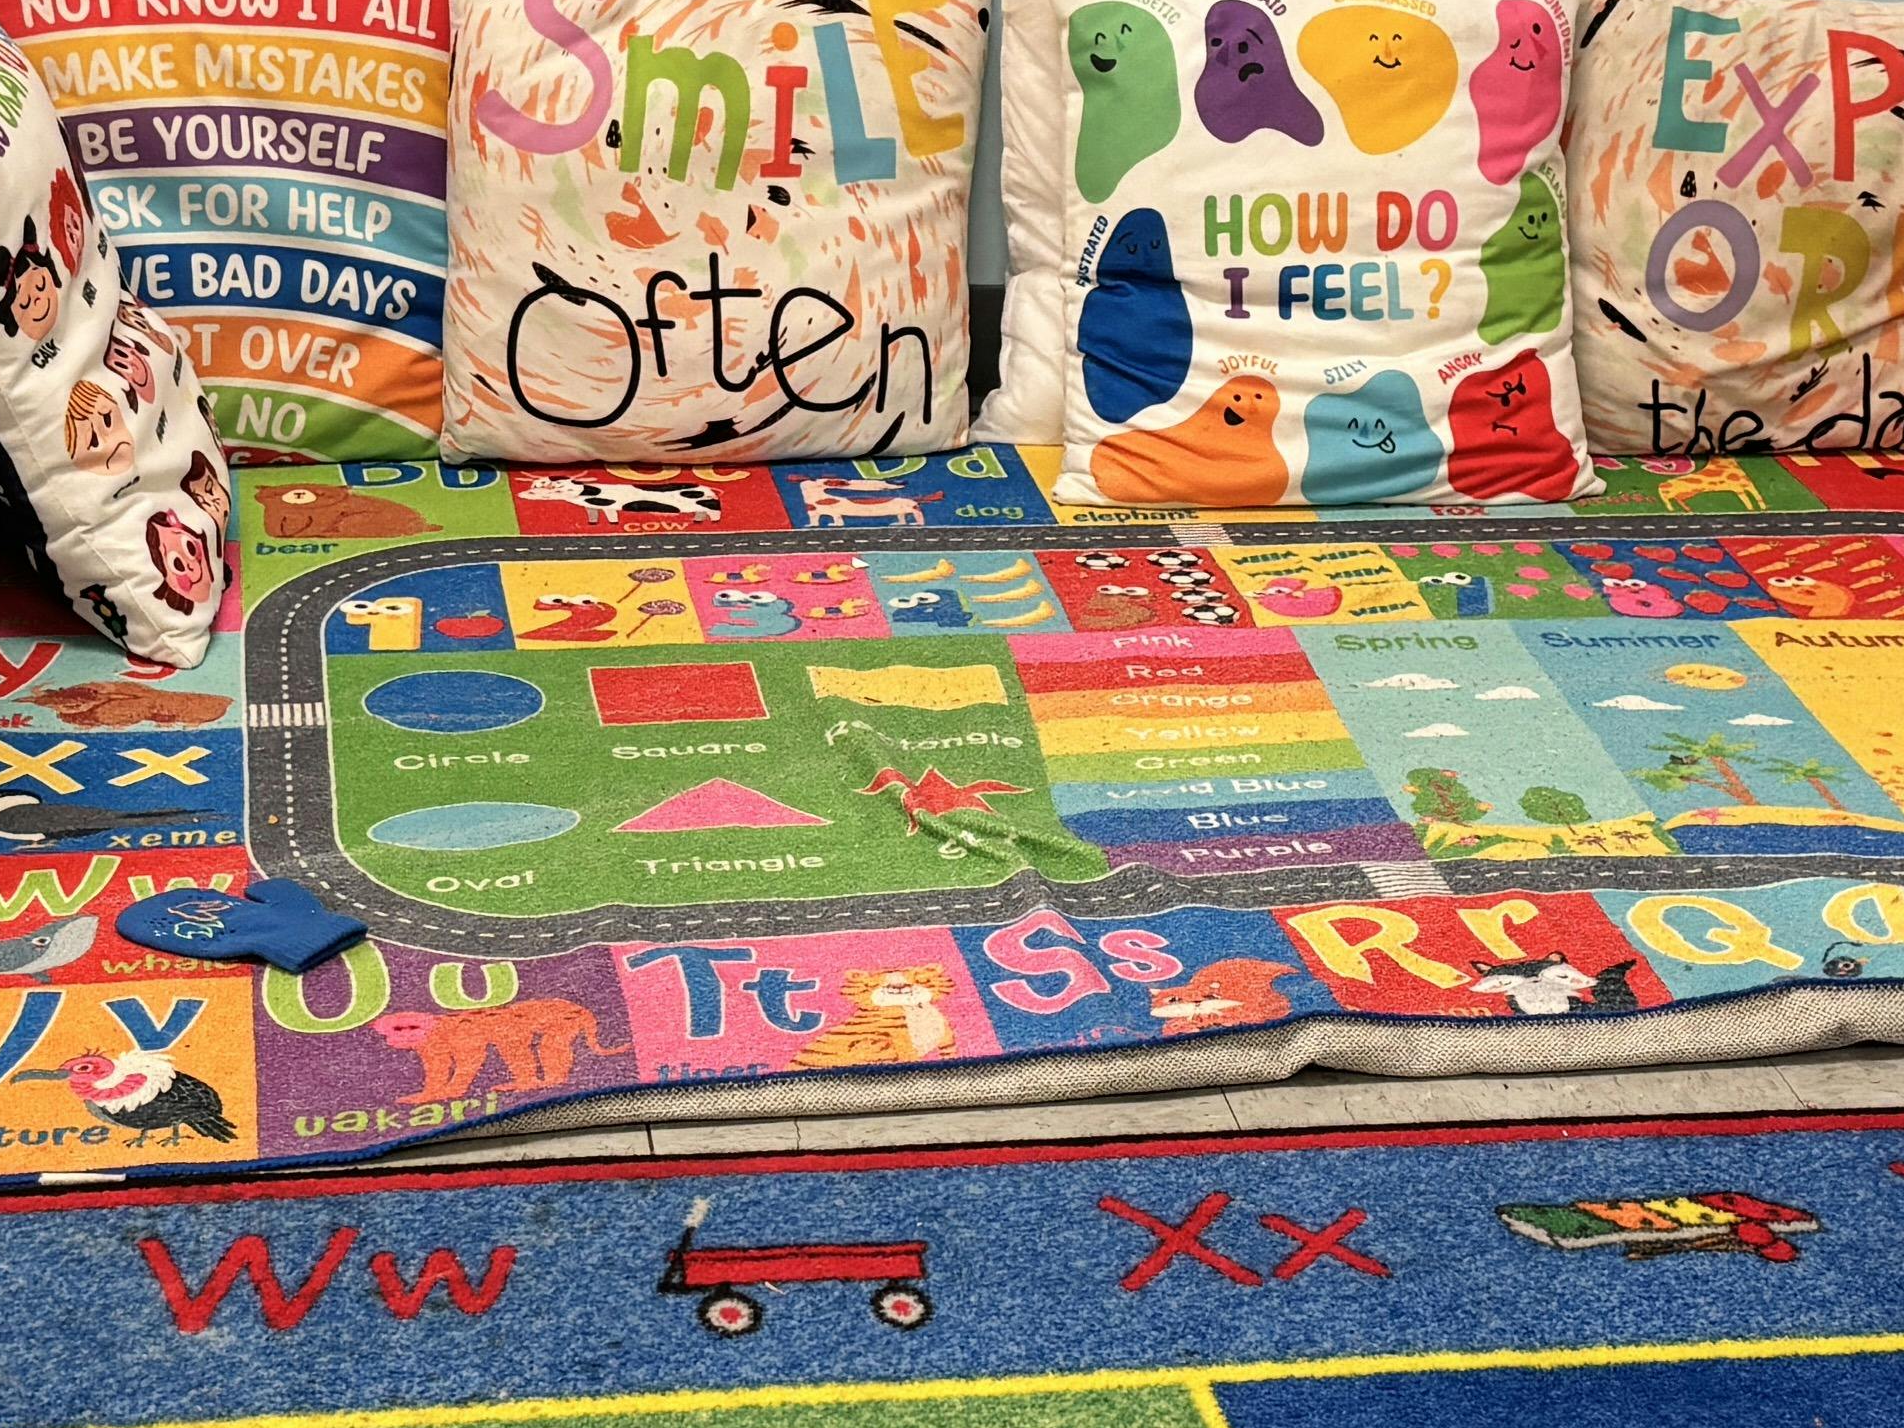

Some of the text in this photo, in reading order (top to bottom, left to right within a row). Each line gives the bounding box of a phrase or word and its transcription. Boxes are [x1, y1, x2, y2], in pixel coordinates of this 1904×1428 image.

[42, 43, 427, 113] MAKE MISTAKES
[78, 114, 385, 175] BE YOURSELF
[179, 183, 392, 243] FOR HELP
[1203, 190, 1459, 257] HOW DO
[192, 253, 282, 301] BAD
[300, 258, 417, 321] DAYS
[1223, 258, 1453, 321] I FEEL?
[239, 324, 360, 388] OVER
[1217, 359, 1280, 376] JOYFUL
[1323, 359, 1367, 386] SILLY
[1436, 353, 1484, 385] ANGRY
[236, 397, 306, 442] NO
[954, 499, 1024, 521] dog
[1113, 632, 1193, 650] Pink
[1332, 631, 1478, 657] Spring
[1540, 631, 1720, 652] Summer
[1125, 664, 1205, 680] Red
[1110, 690, 1254, 710] Orange
[1124, 723, 1260, 742] Yellow
[394, 737, 767, 772] Circle Square
[1133, 751, 1260, 771] Green
[107, 826, 238, 848] xeme
[1188, 812, 1290, 832] Blue
[1179, 839, 1333, 864] Purple
[426, 849, 825, 895] Oval Triangle
[294, 1090, 498, 1140] uakari
[1096, 1191, 1395, 1293] Xx
[136, 1225, 520, 1335] Ww
